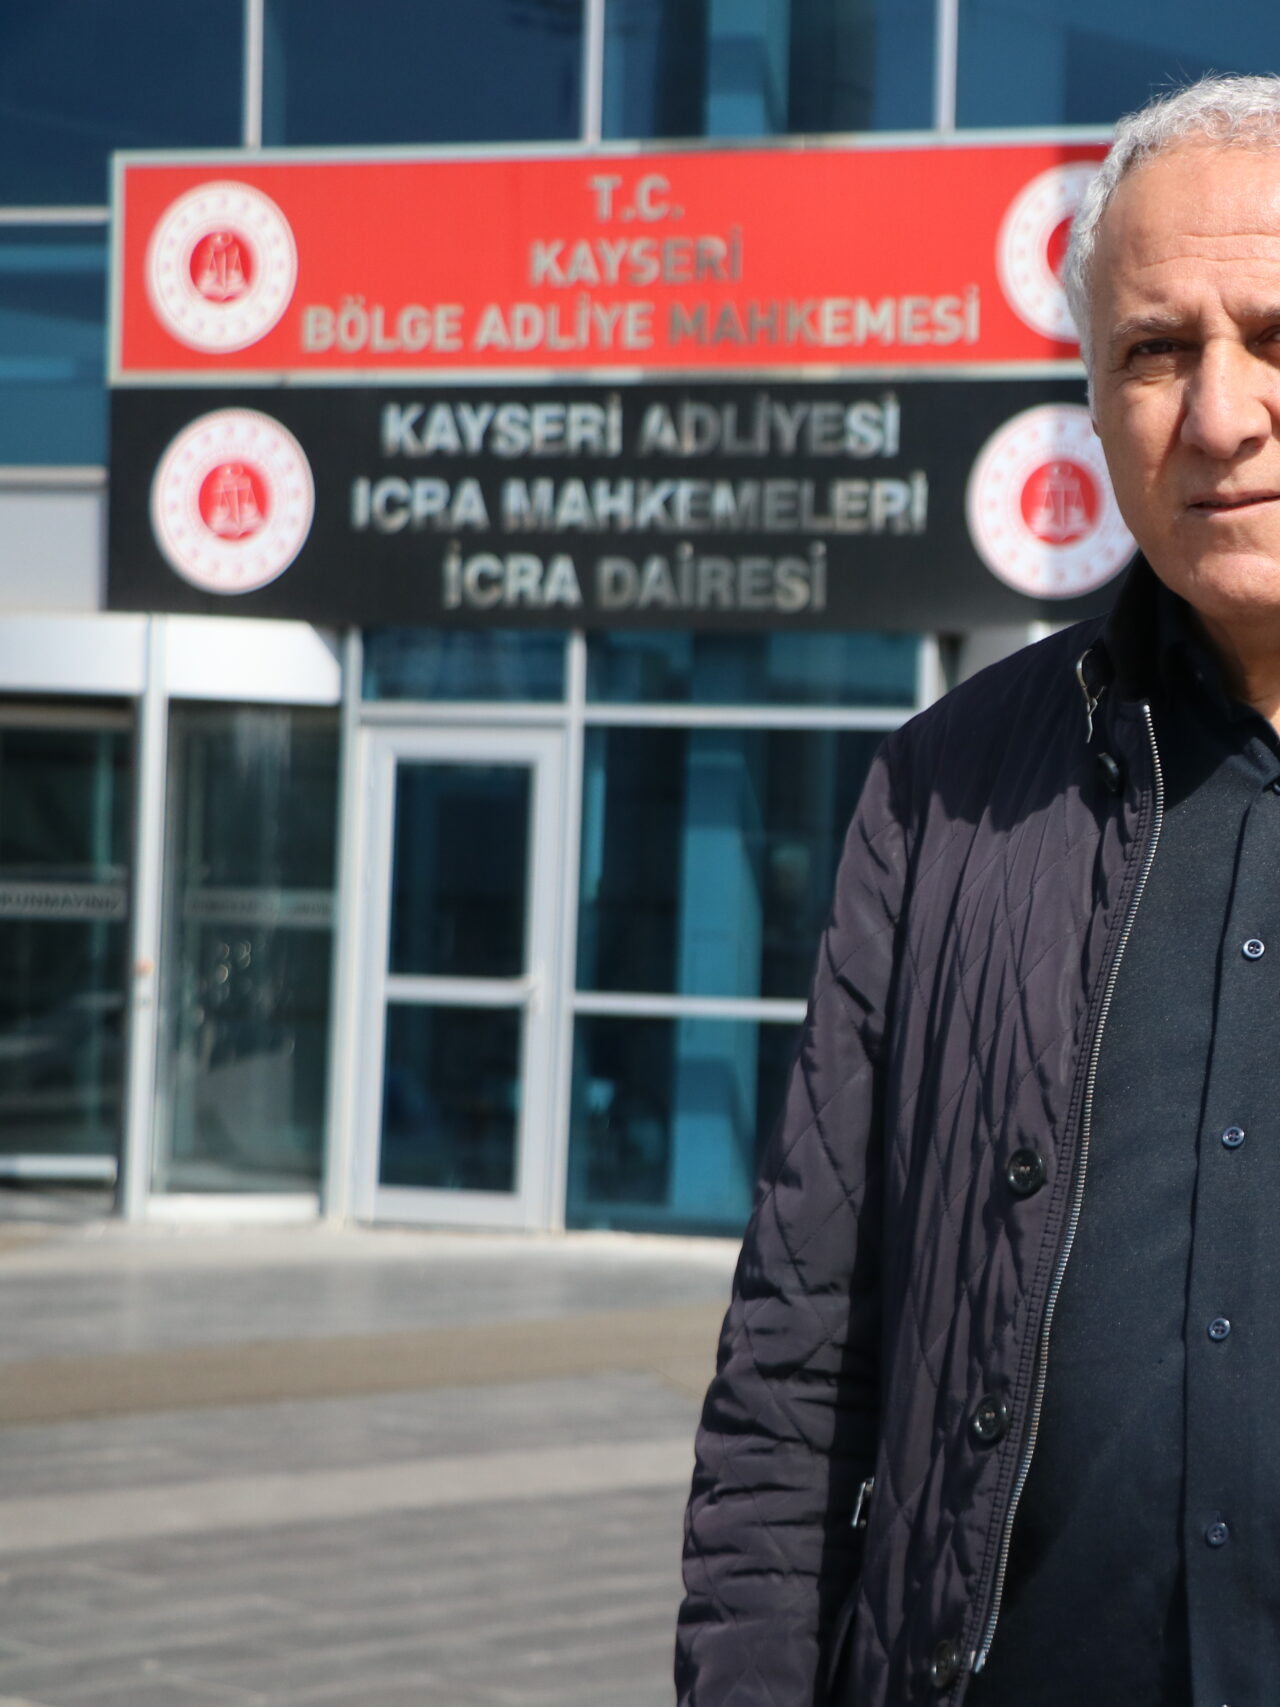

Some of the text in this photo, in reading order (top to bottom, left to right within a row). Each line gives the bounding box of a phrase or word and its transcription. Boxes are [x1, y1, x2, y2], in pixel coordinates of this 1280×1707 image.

[588, 174, 684, 221] T.C.
[530, 225, 742, 286] KAYSERİ
[303, 284, 980, 352] BÖLGE ADLİYE MAHKEMESİ
[381, 392, 900, 457] KAYSERİ ADLİYESİ
[503, 470, 928, 534] MAHKEMELERİ
[443, 540, 828, 611] İCRA DAİRESİ
